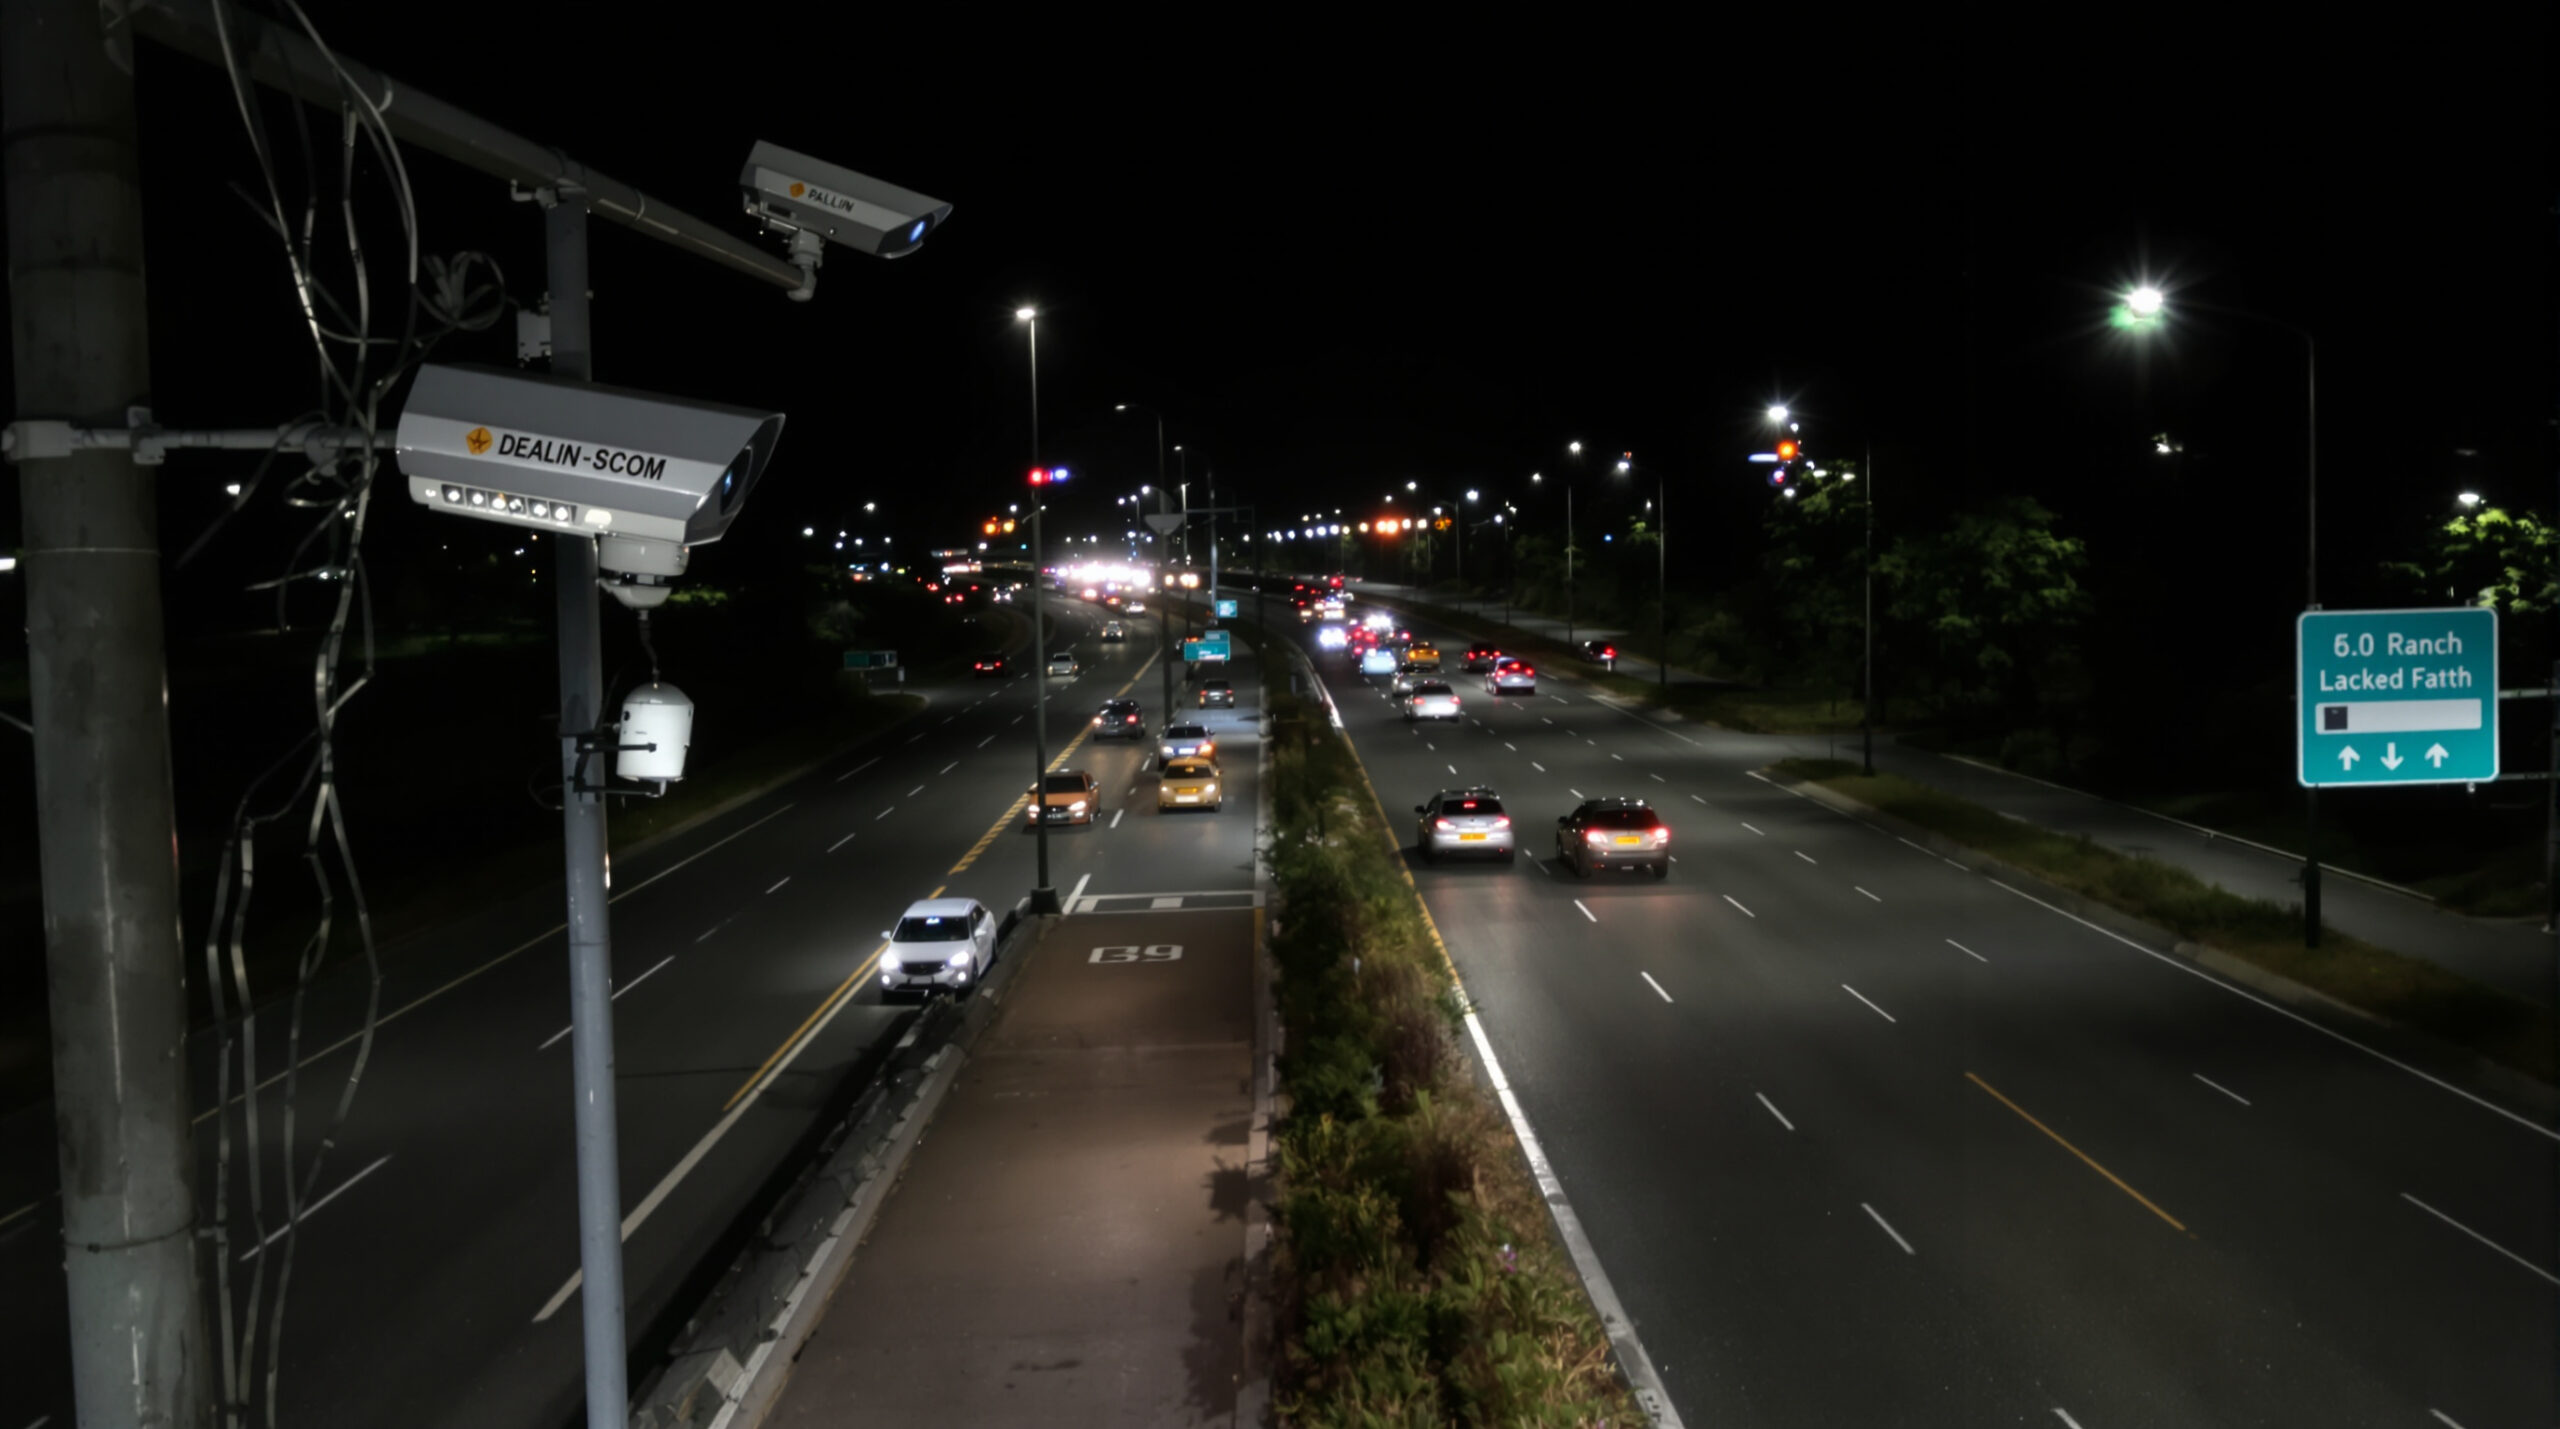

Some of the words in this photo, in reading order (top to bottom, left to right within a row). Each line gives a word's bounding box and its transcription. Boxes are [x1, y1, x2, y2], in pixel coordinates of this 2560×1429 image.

[498, 433, 667, 481] DEALIN-SCOM
[2386, 630, 2463, 656] Ranch
[2319, 667, 2404, 692] Lacked
